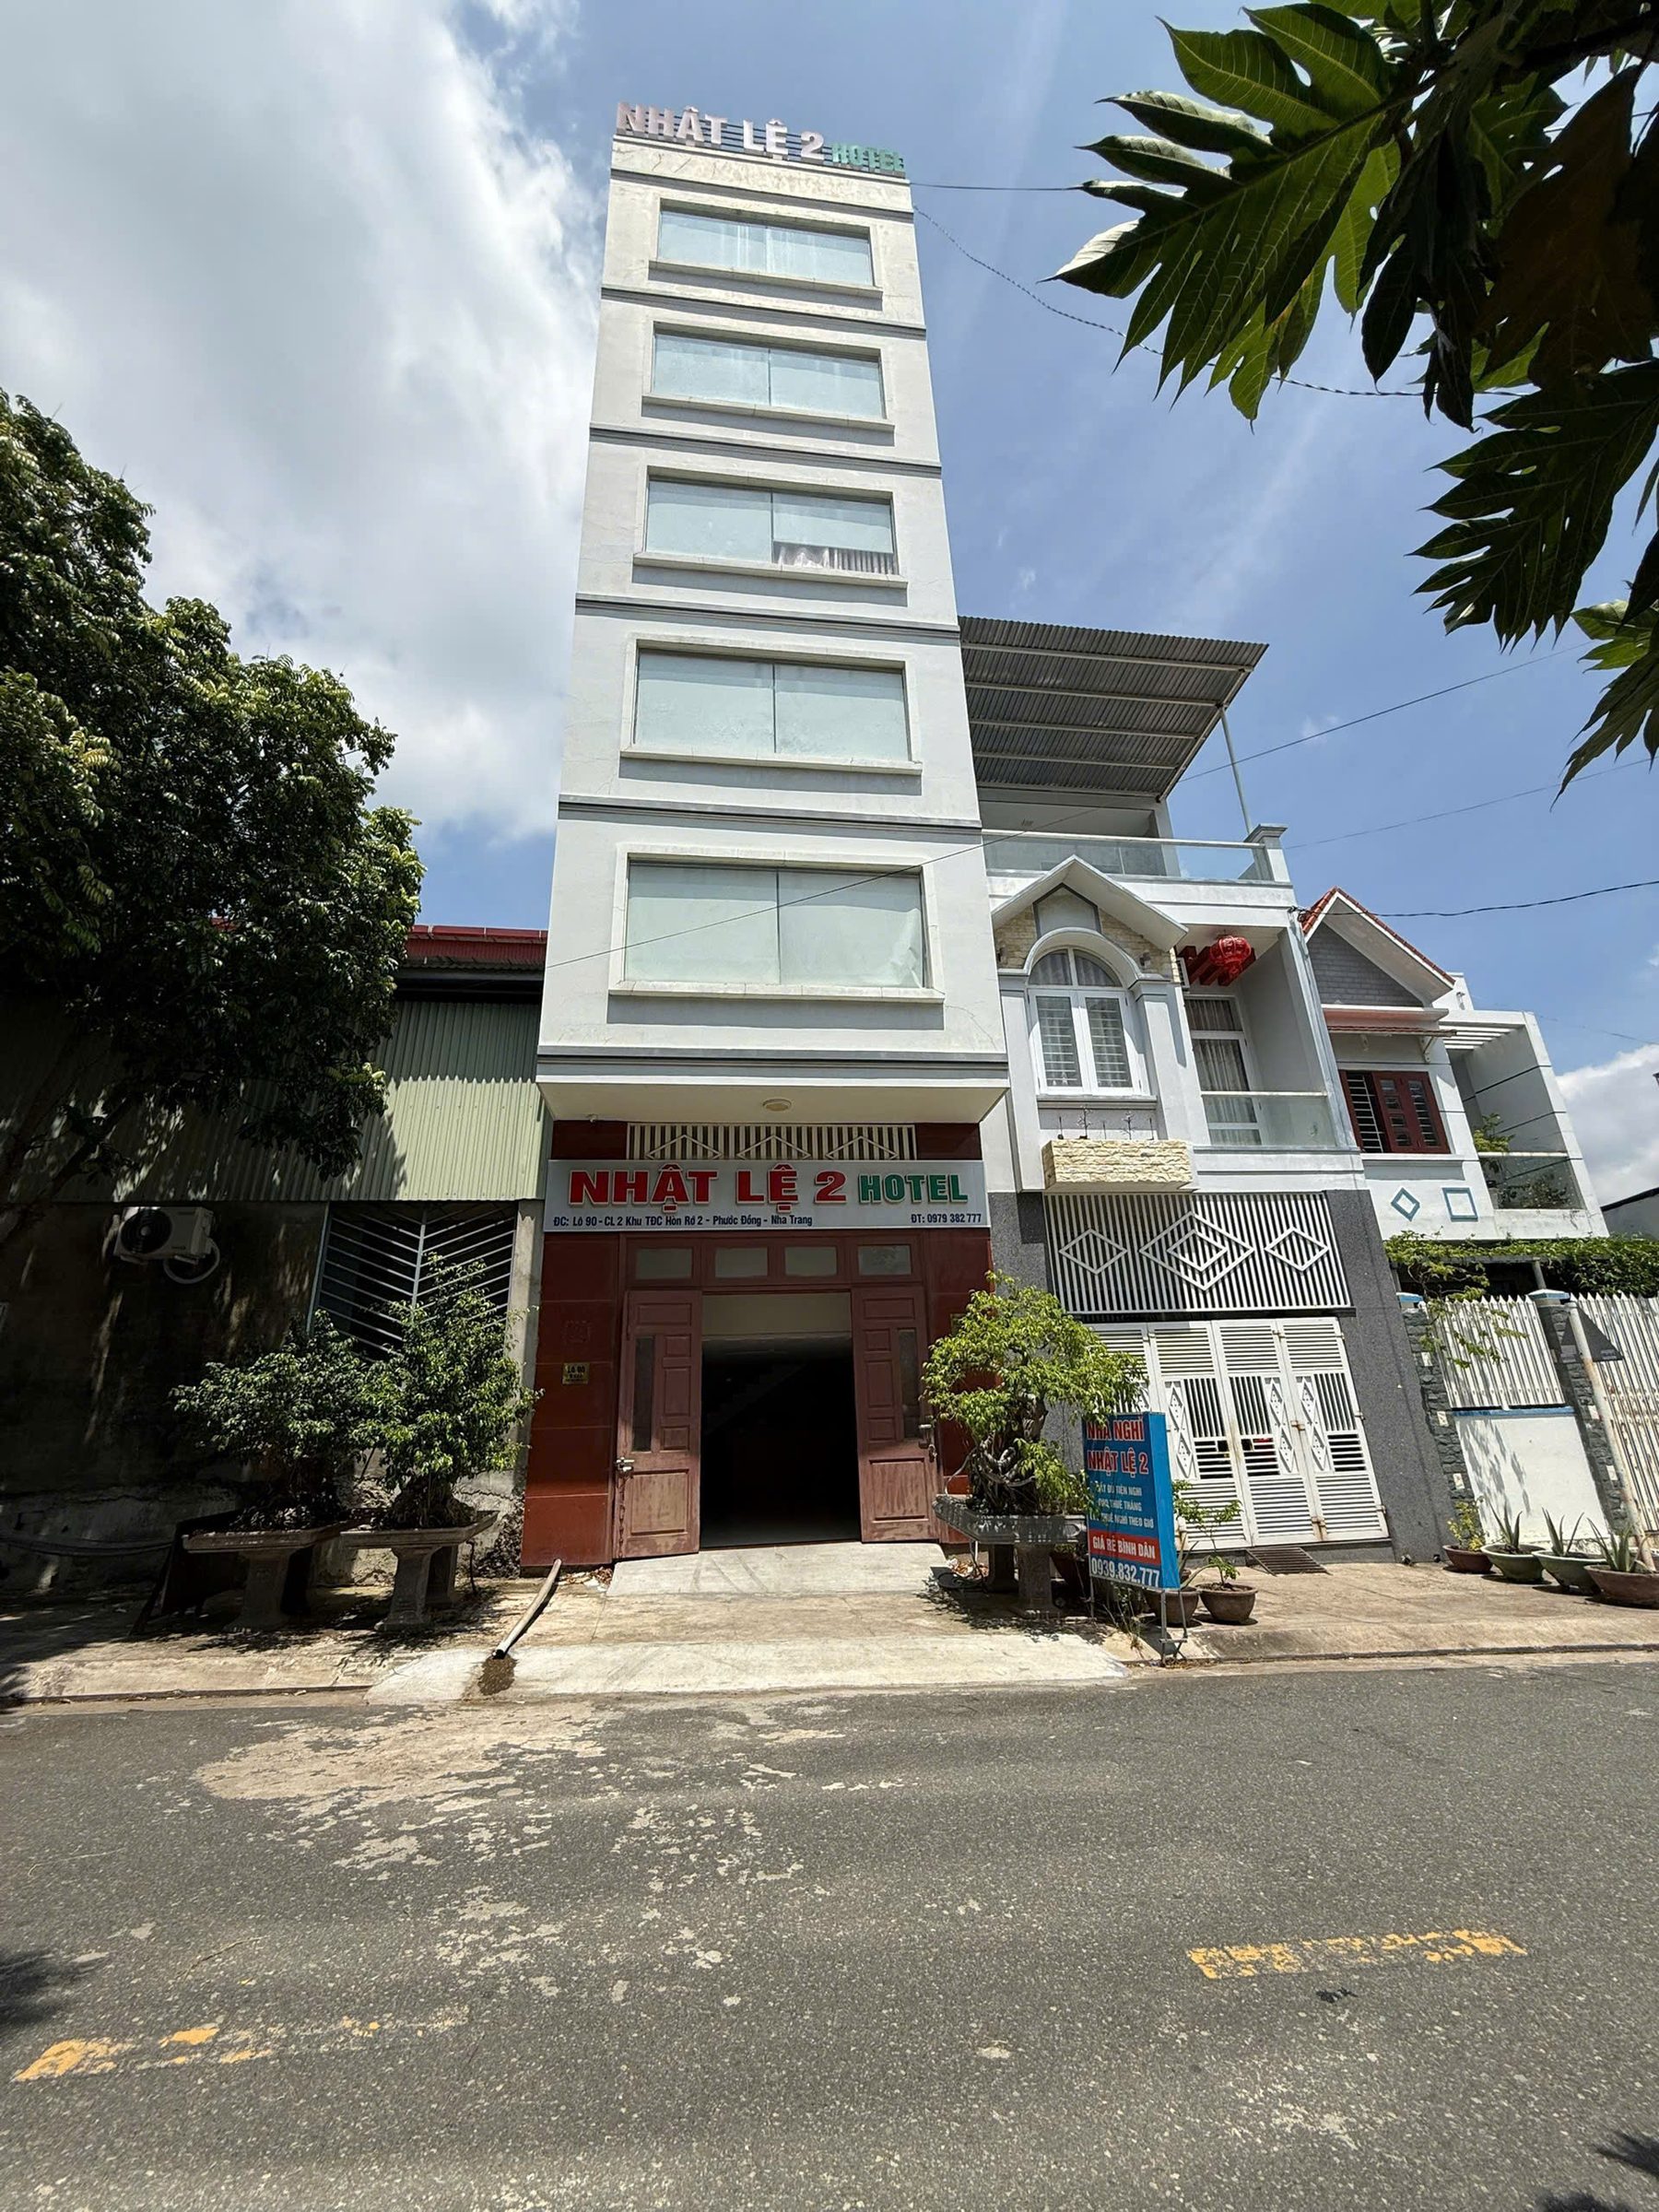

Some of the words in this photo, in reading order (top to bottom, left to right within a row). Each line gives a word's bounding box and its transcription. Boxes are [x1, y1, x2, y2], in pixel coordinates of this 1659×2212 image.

[800, 131, 825, 161] 2
[830, 142, 906, 174] HOTEL
[569, 1162, 718, 1214] NHẬT
[735, 1162, 799, 1214] LỆ
[814, 1170, 847, 1204] 2
[857, 1173, 969, 1205] HOTEL
[553, 1216, 570, 1227] ĐC:
[585, 1216, 597, 1227] 90
[604, 1216, 616, 1227] CL
[617, 1216, 624, 1227] 2
[626, 1216, 642, 1227] Khu
[645, 1216, 663, 1226] TĐC
[697, 1215, 703, 1226] 2
[771, 1214, 787, 1225] Nha
[790, 1215, 813, 1226] Trang
[911, 1213, 925, 1223] ĐT:
[927, 1213, 947, 1223] 0979
[949, 1213, 966, 1223] 382
[967, 1213, 982, 1223] 777
[1088, 1446, 1118, 1477] NHẬT
[1121, 1447, 1136, 1478] LỆ
[1138, 1452, 1148, 1475] 2
[1092, 1534, 1105, 1550] GIÁ
[1117, 1537, 1136, 1557] BÌNH
[1137, 1541, 1156, 1559] DÂN
[1091, 1558, 1159, 1587] 0939.832.777
